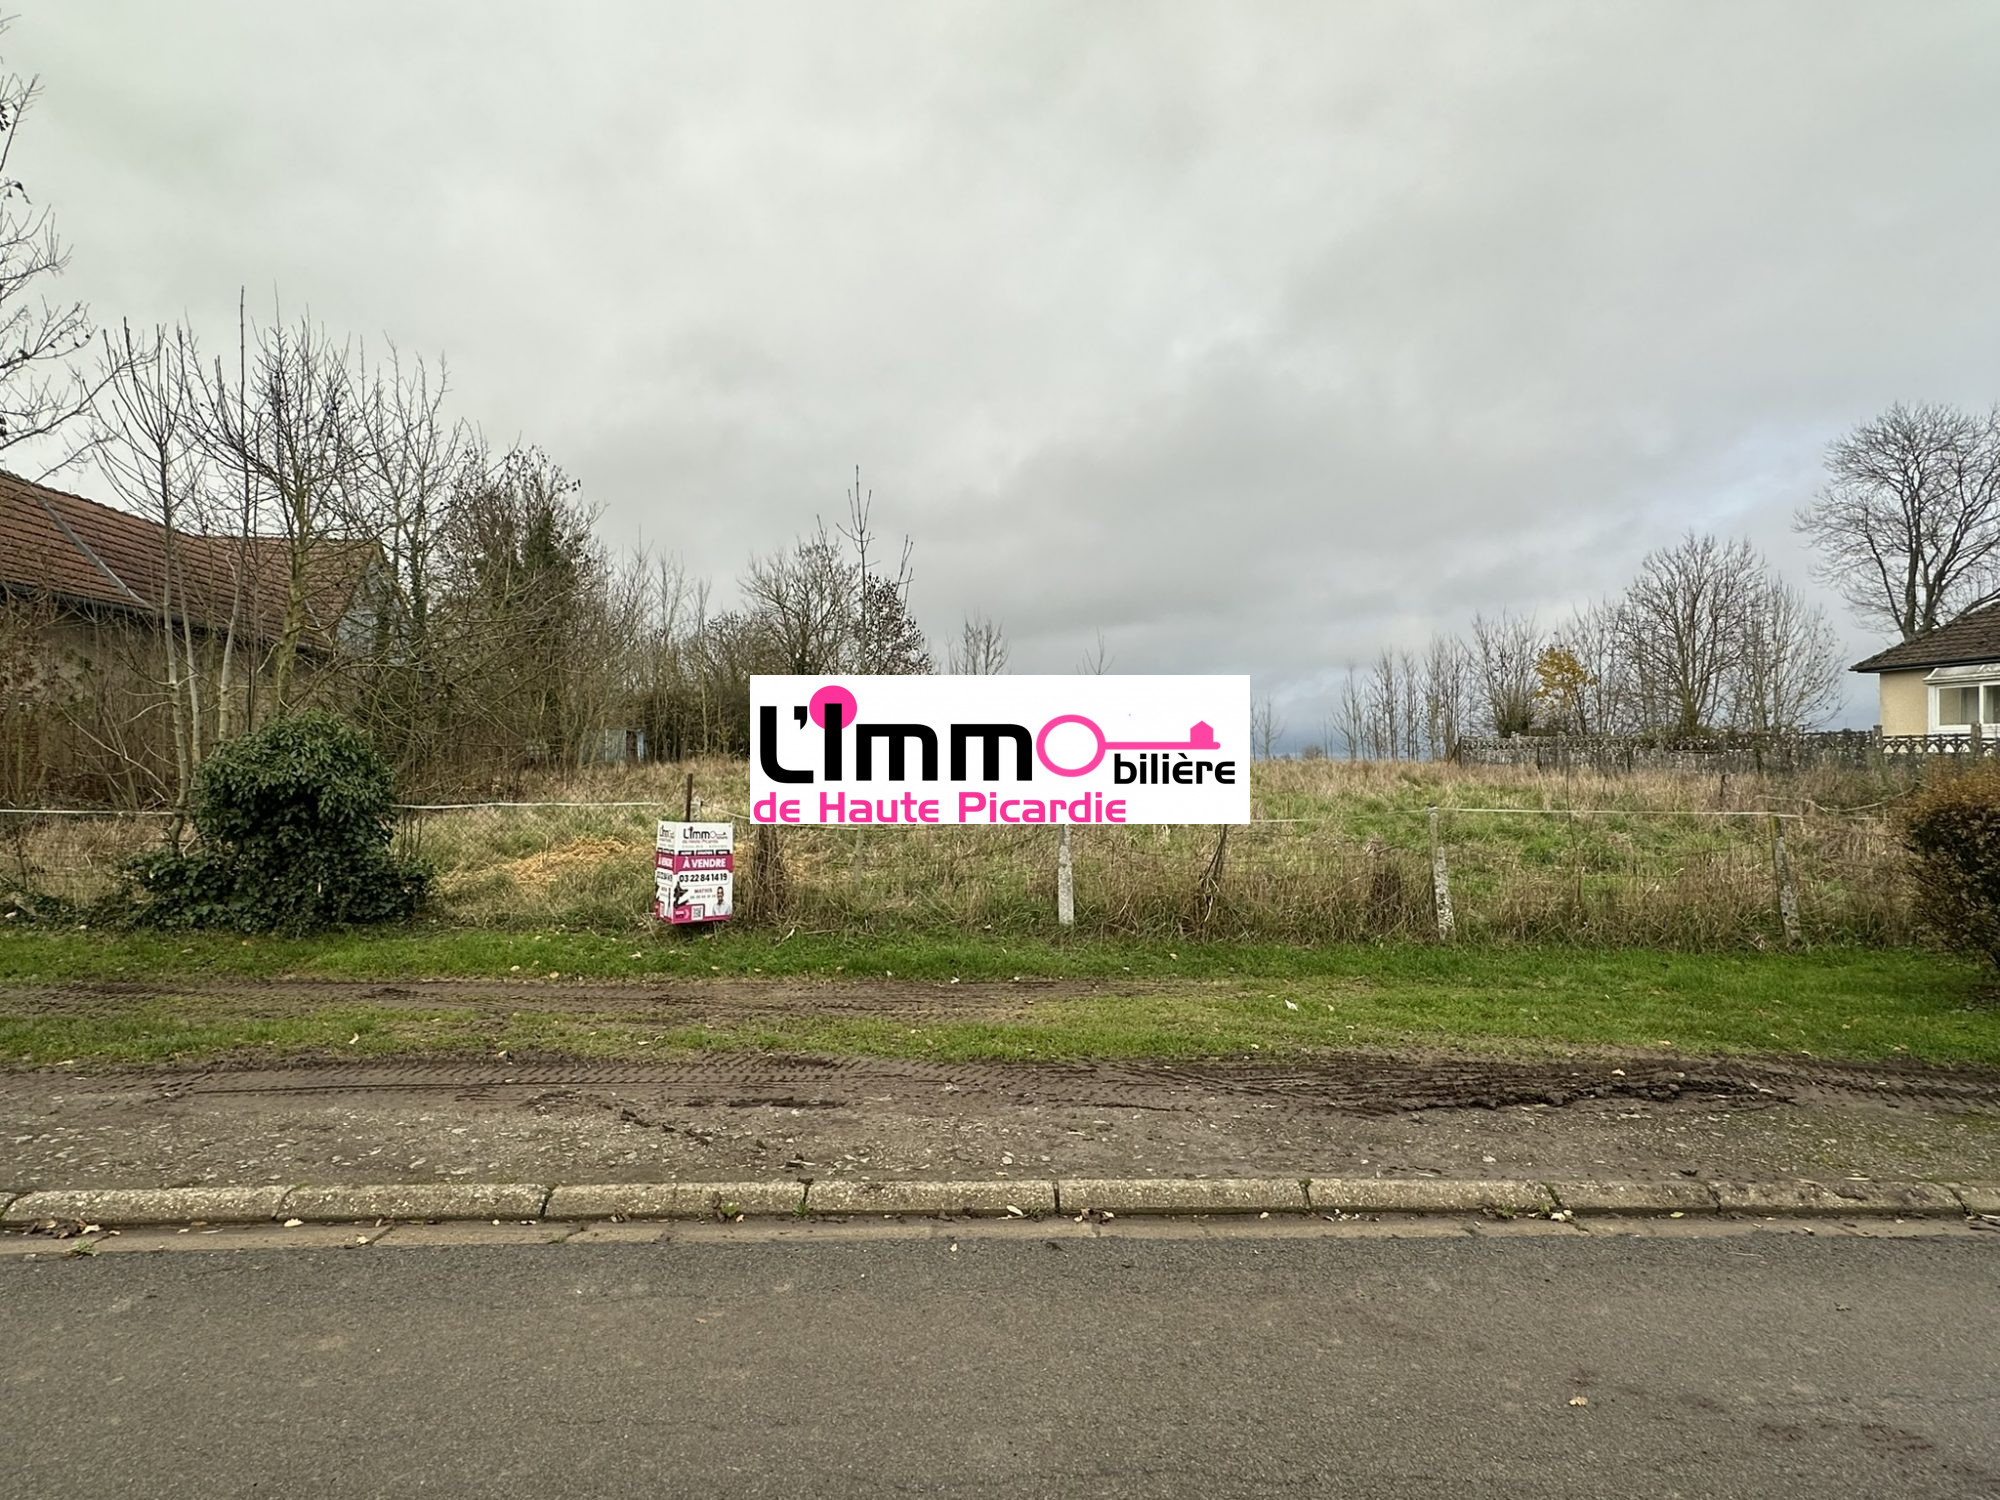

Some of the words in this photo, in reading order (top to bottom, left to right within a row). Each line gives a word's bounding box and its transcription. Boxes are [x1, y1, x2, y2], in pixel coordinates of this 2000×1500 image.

[682, 856, 690, 868] À
[691, 858, 726, 868] VENDRE
[679, 874, 689, 883] 03
[690, 874, 699, 882] 22
[700, 873, 710, 882] 84
[711, 873, 719, 881] 14
[720, 873, 727, 881] 19
